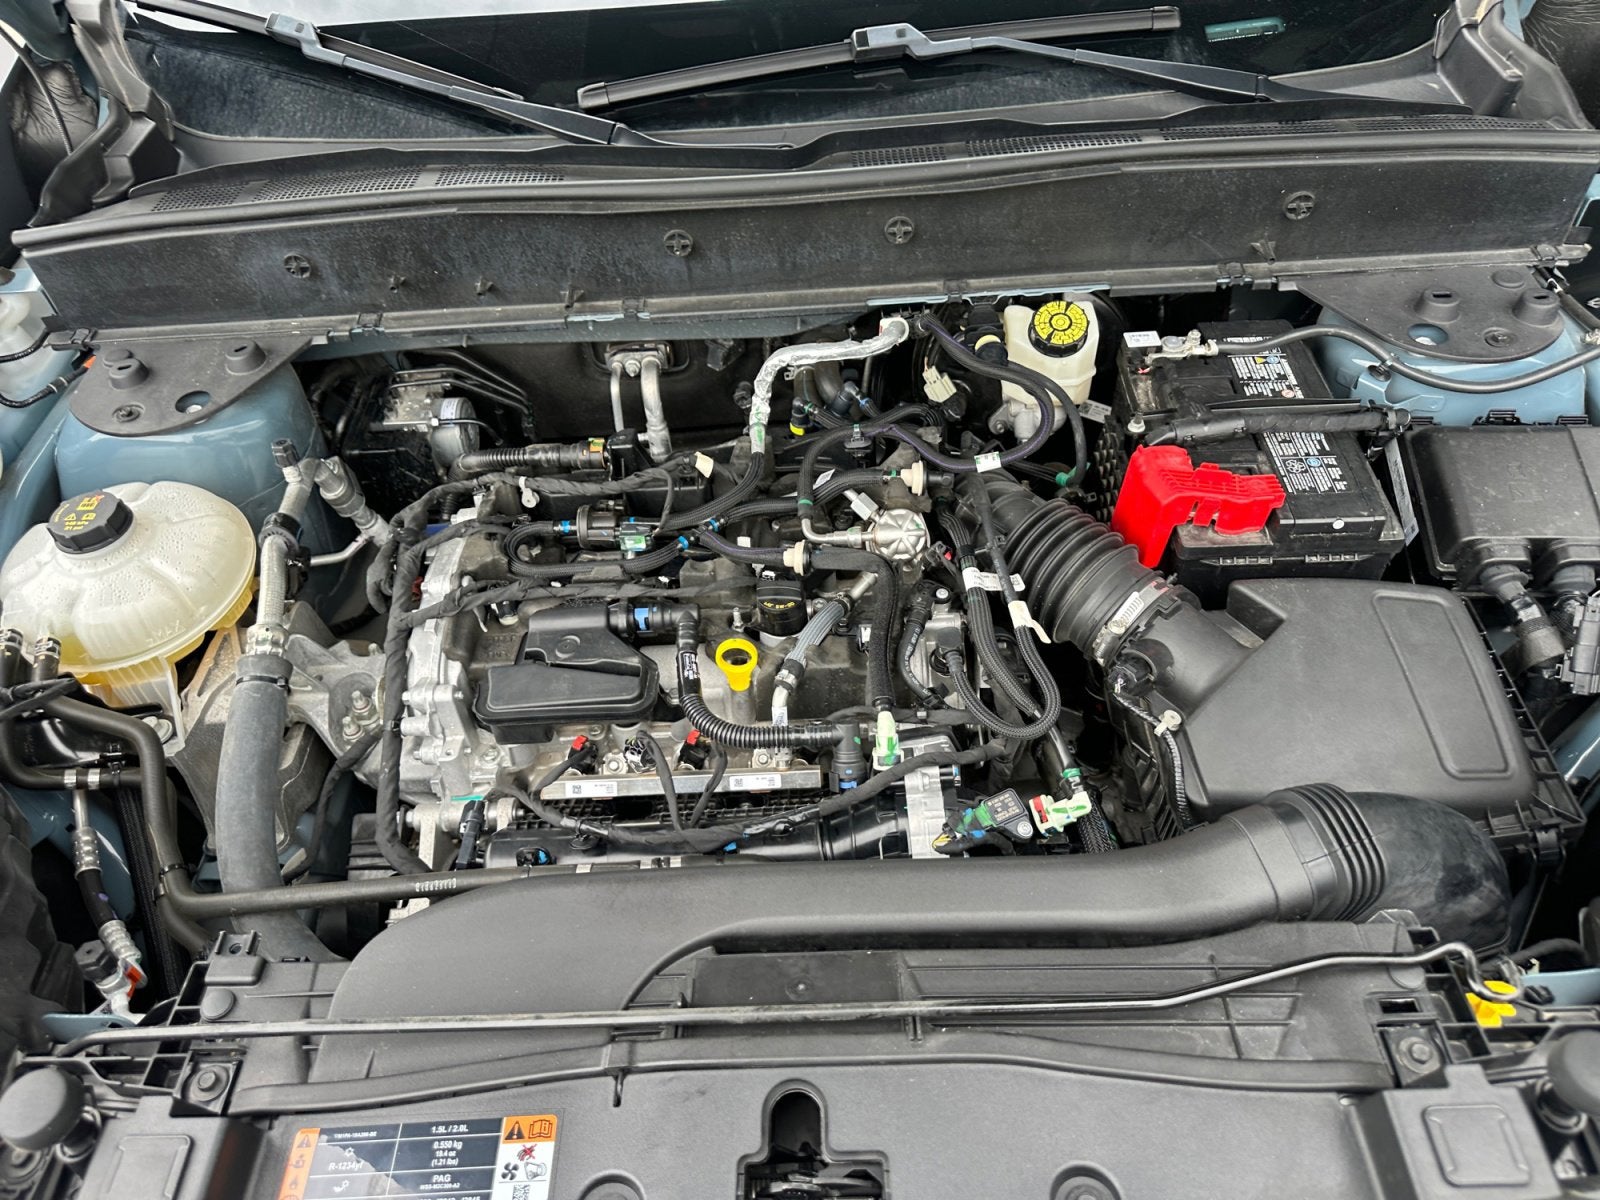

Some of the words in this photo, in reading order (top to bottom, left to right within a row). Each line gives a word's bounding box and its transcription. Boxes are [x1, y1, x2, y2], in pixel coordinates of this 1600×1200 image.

[431, 1125, 447, 1134] 1.5L
[452, 1124, 469, 1133] 2.0L
[433, 1140, 453, 1149] 0.550
[453, 1139, 463, 1150] kg
[432, 1173, 452, 1183] PAG
